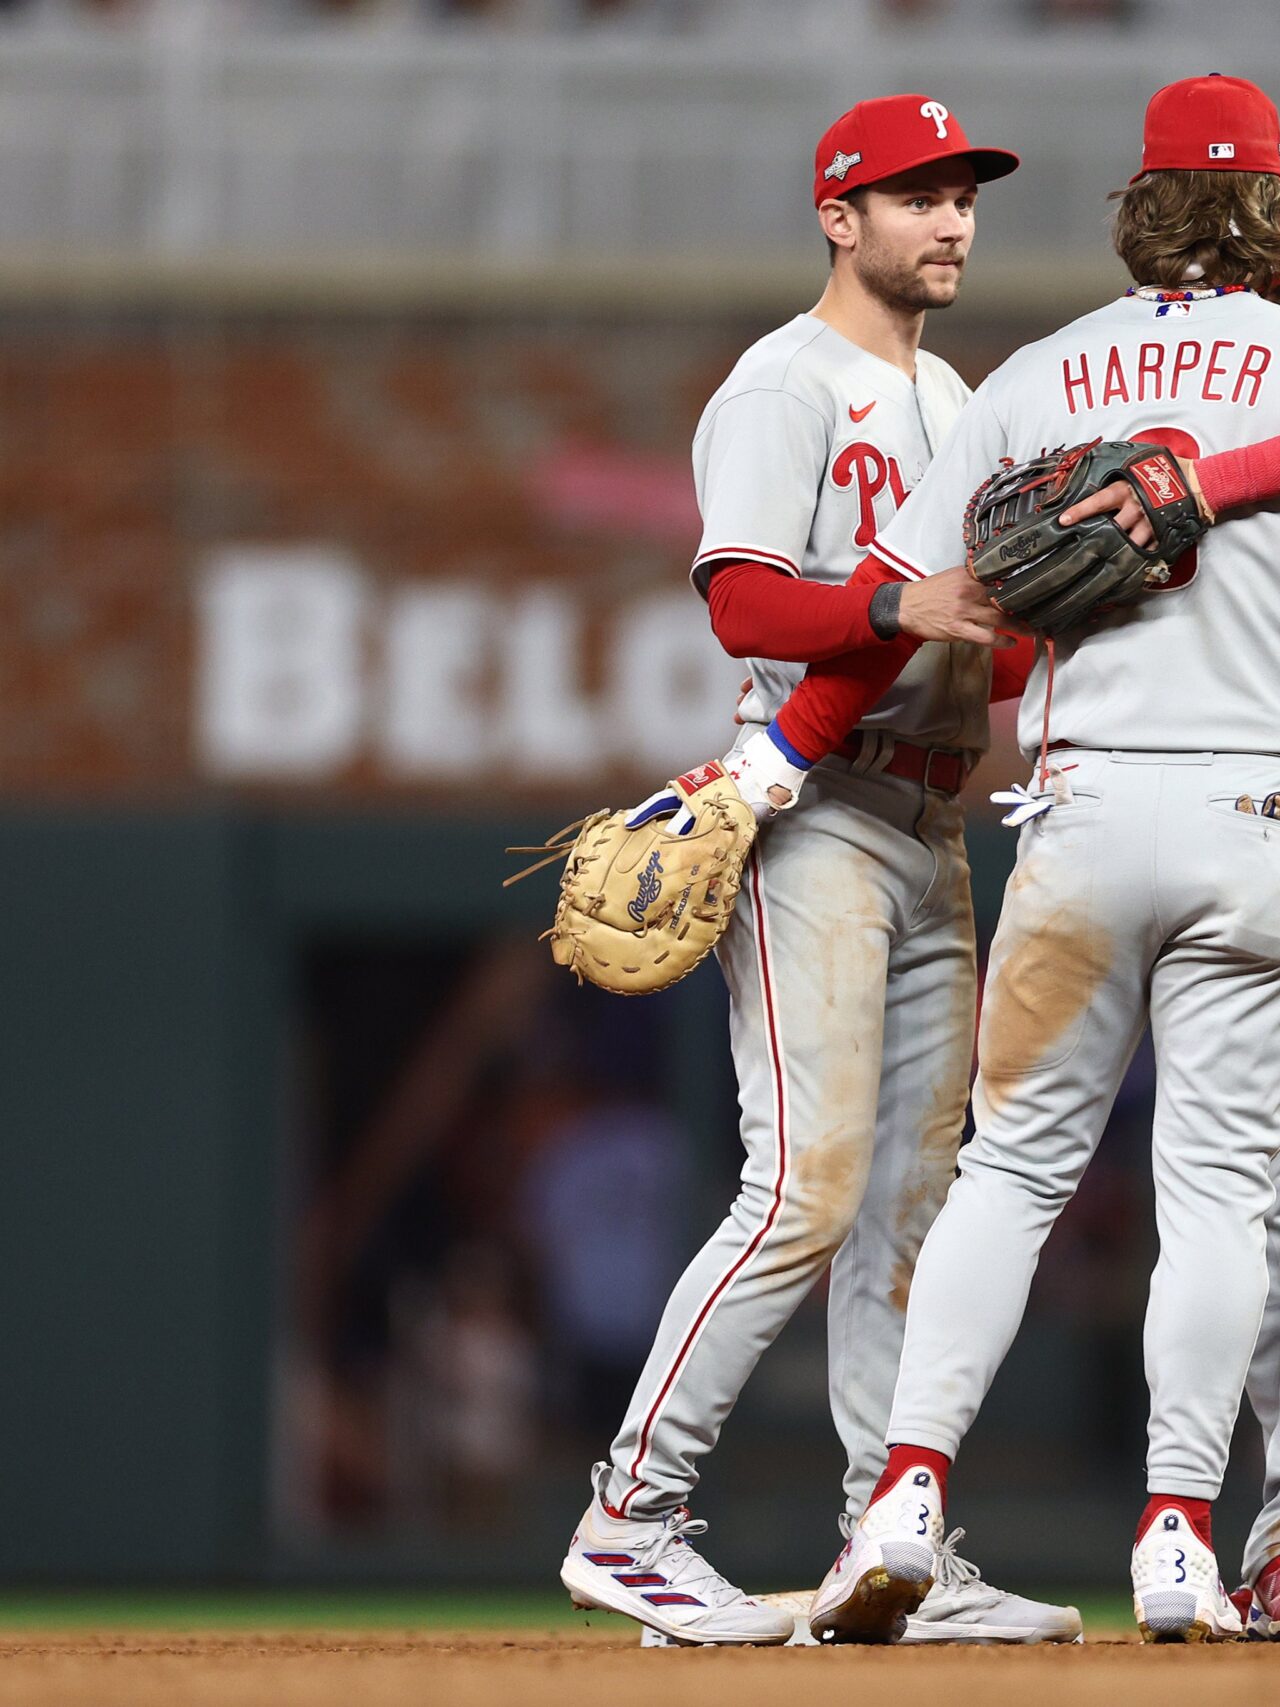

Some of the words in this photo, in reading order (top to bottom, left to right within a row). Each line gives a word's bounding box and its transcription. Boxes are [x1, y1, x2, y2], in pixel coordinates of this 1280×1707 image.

[920, 101, 948, 139] P
[1062, 340, 1272, 415] HARPER
[1142, 464, 1175, 499] Rawlings
[999, 530, 1042, 561] Rawlings
[627, 850, 664, 923] Rawlings
